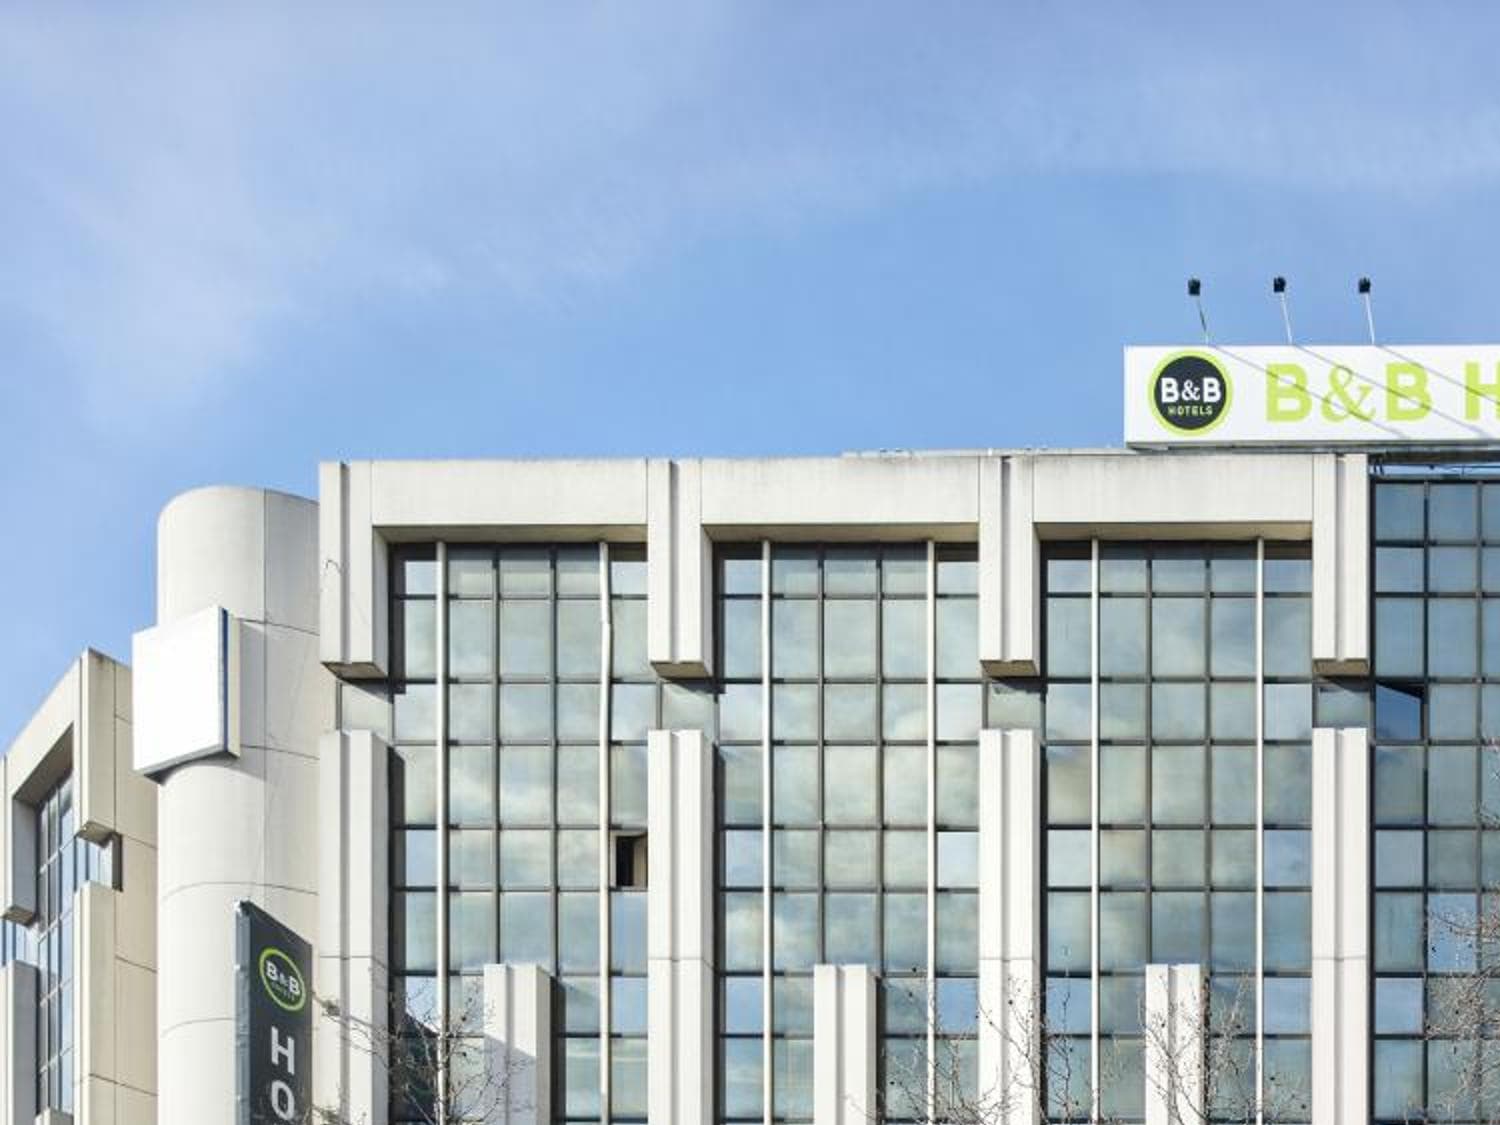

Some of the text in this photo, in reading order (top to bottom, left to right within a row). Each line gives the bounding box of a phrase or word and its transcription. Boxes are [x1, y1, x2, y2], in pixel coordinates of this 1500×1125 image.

[1161, 376, 1221, 403] B&B
[1266, 362, 1432, 422] B&B
[1167, 405, 1213, 416] HOTELS
[266, 960, 301, 996] B&B
